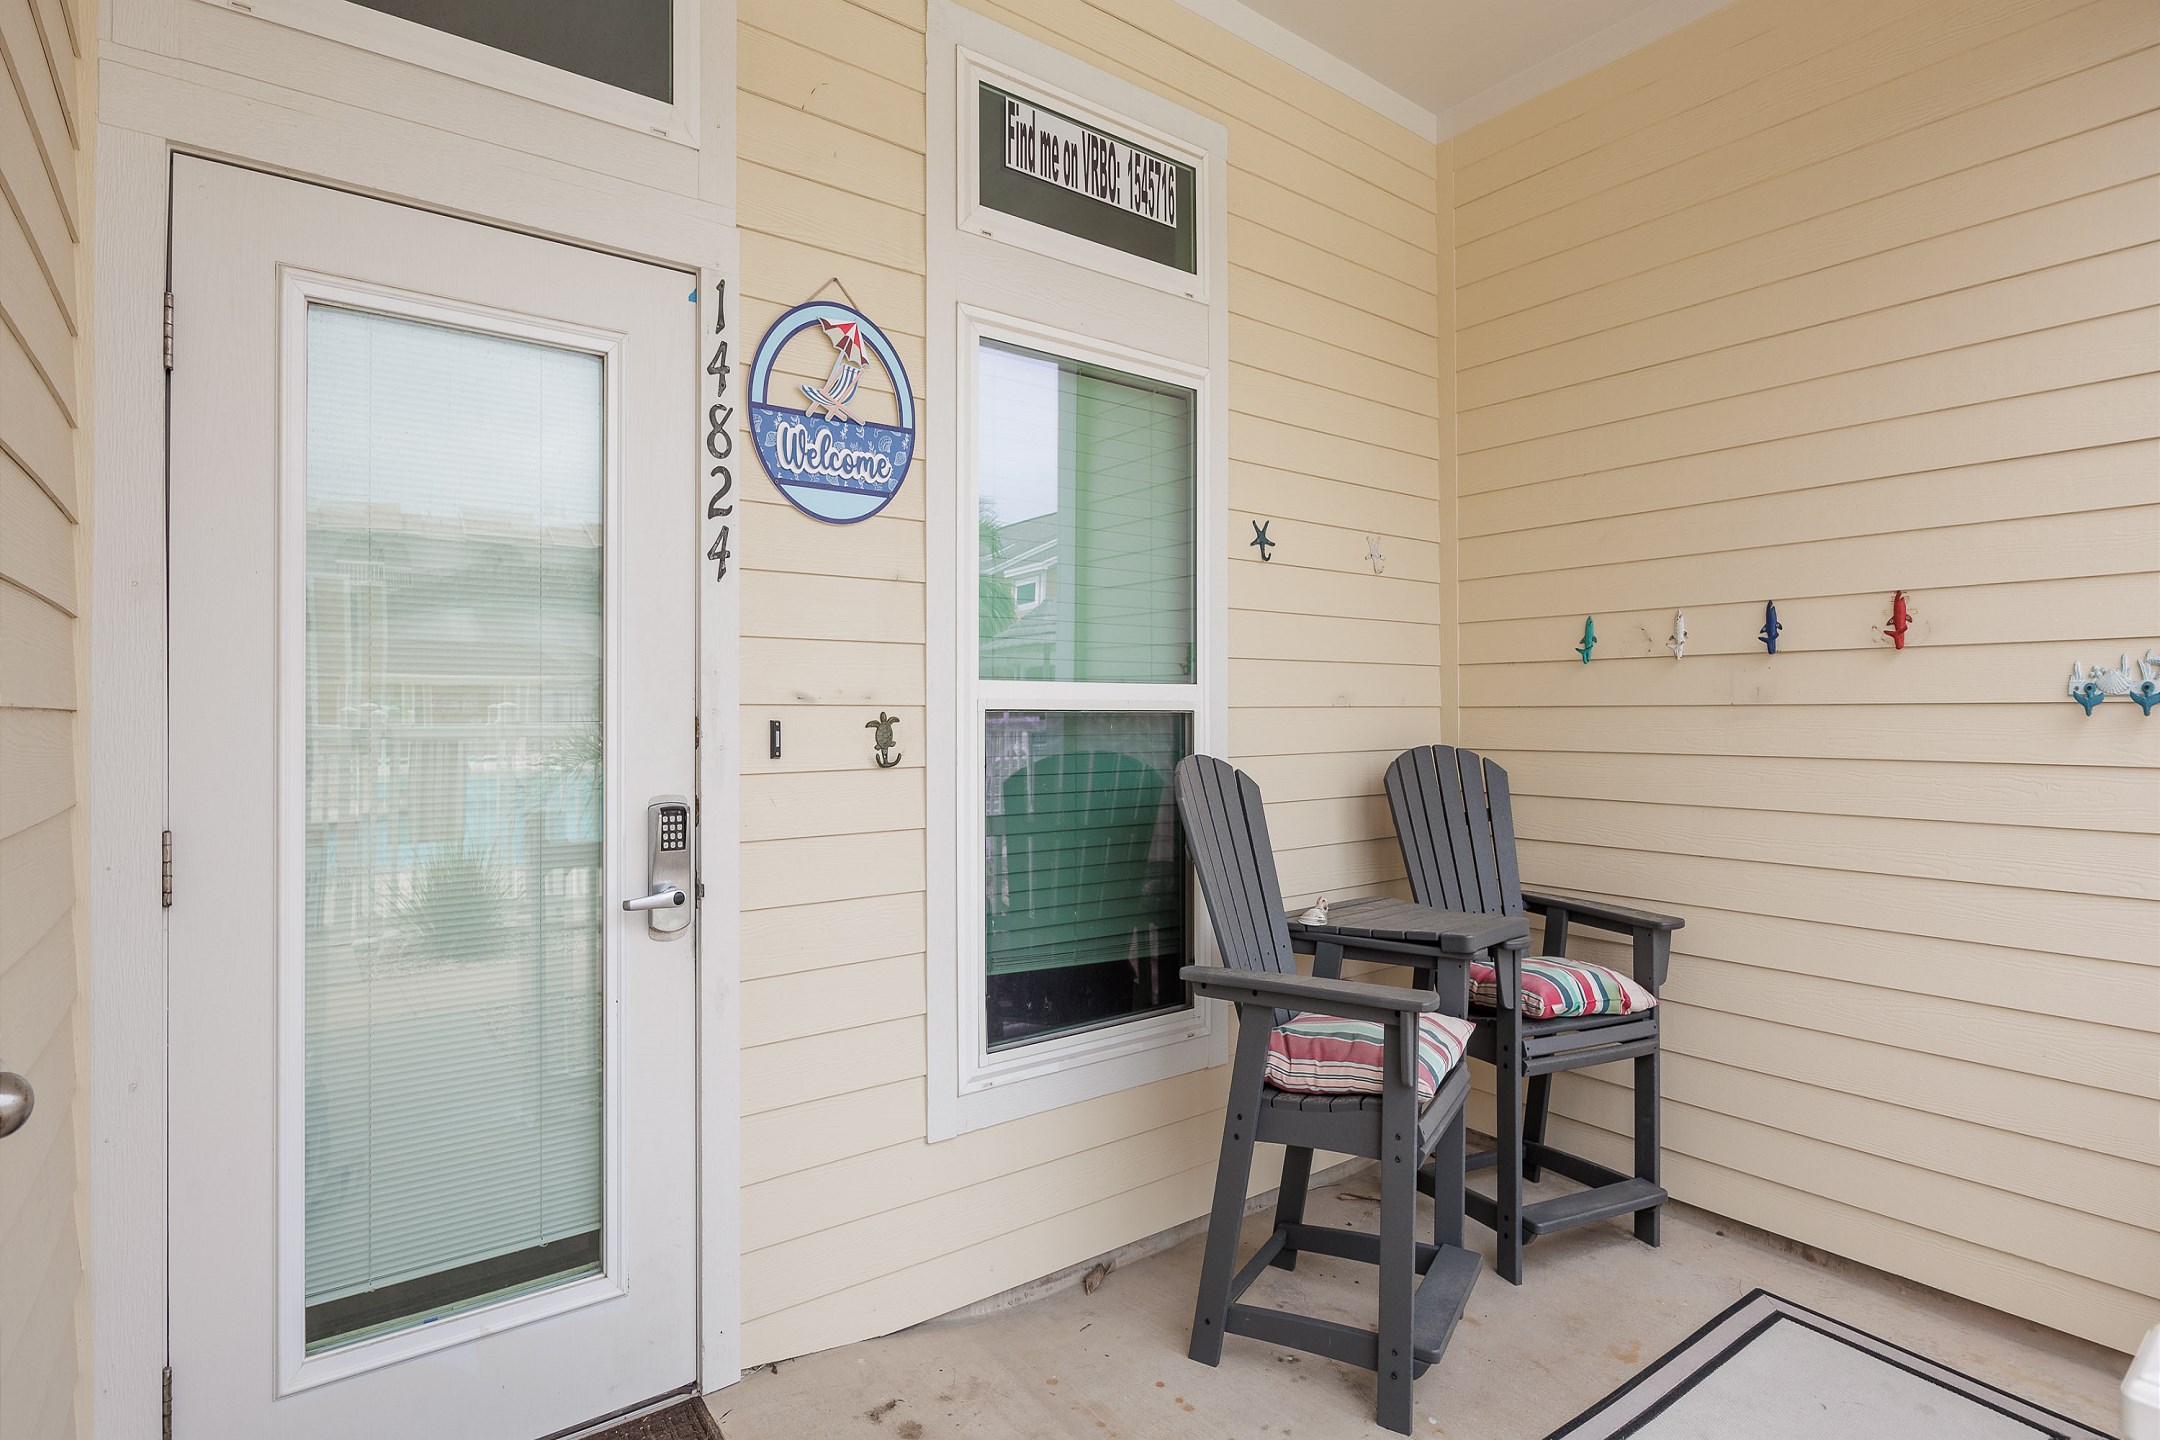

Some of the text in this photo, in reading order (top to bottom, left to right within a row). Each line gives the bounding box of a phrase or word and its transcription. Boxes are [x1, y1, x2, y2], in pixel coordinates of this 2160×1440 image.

[1007, 99, 1176, 225] Find me on VRBO: 1545716
[706, 278, 733, 583] 14824
[780, 423, 892, 482] Welcome
